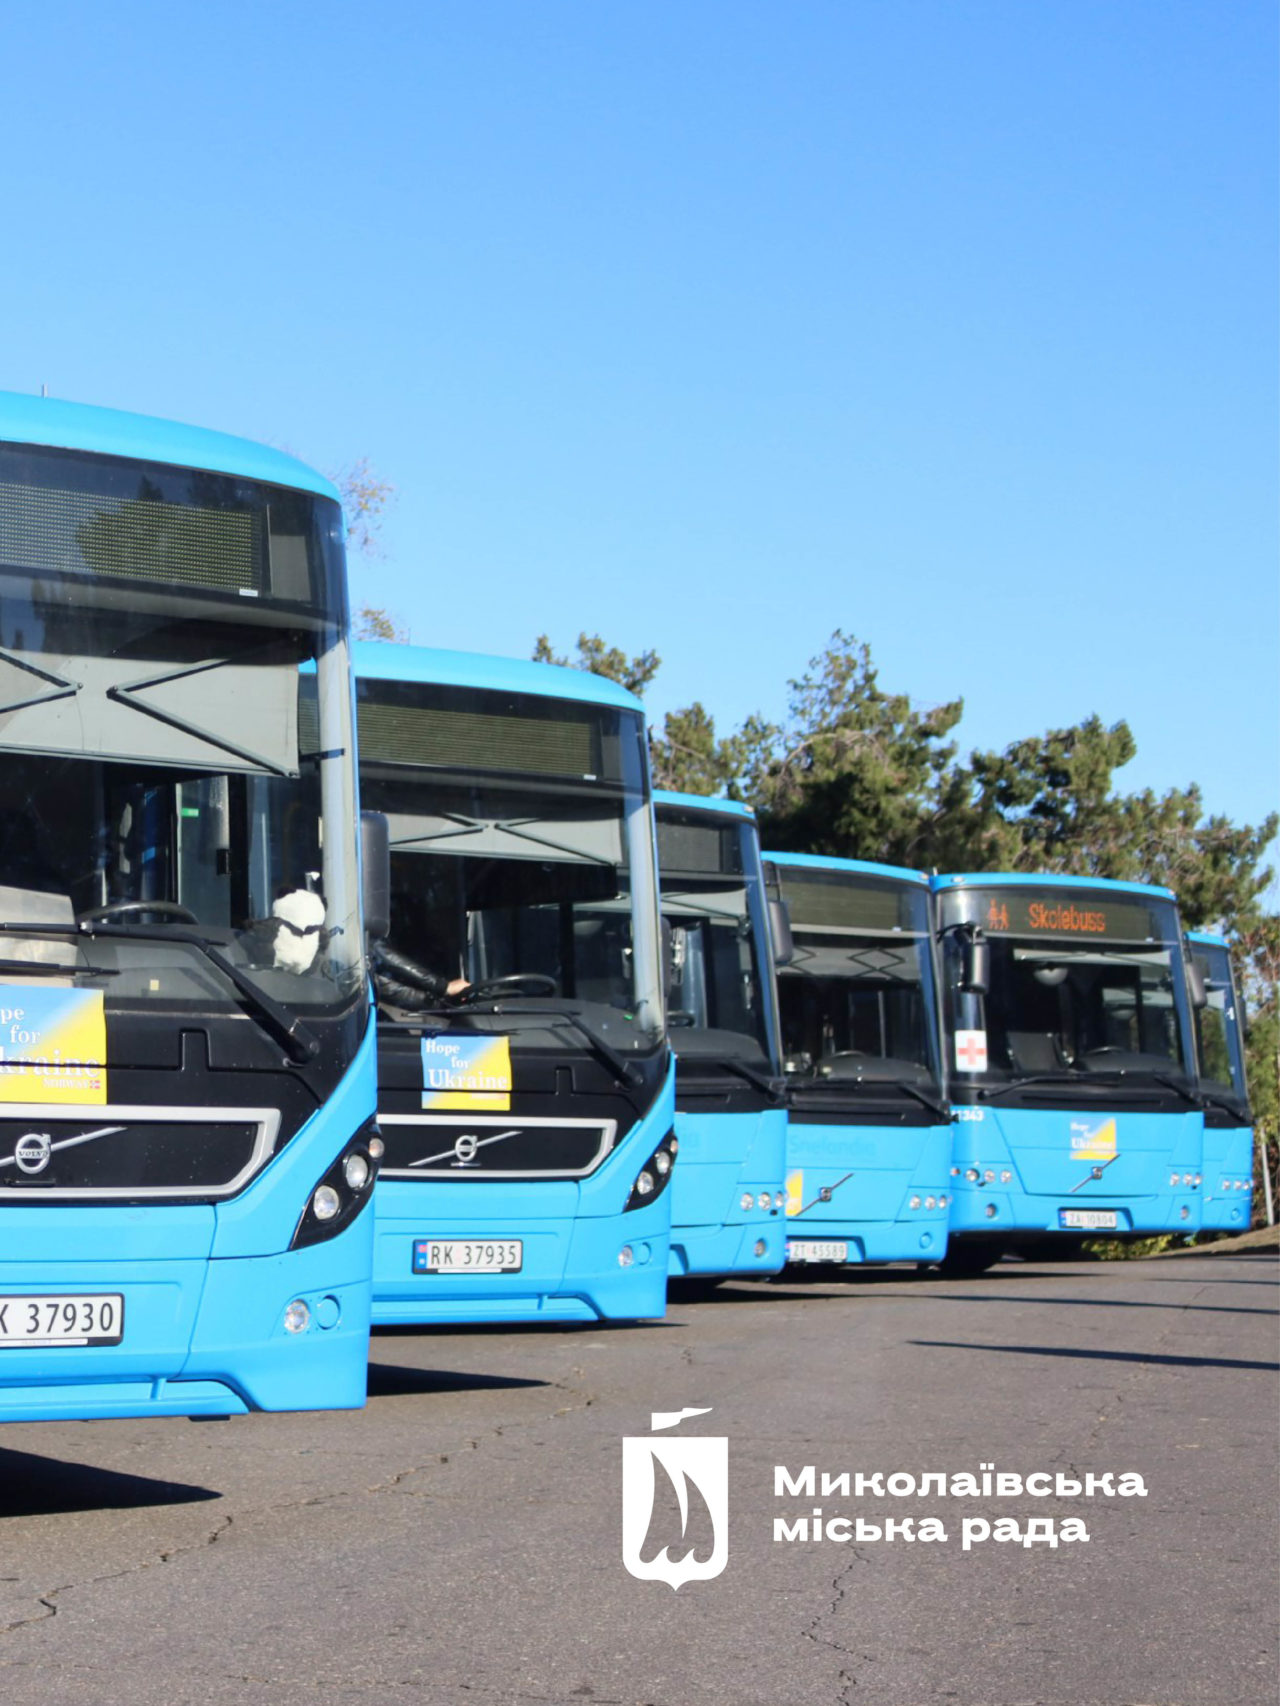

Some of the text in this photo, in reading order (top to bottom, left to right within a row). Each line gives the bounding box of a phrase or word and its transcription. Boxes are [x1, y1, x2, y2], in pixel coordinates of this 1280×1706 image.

[1028, 903, 1106, 932] Skolebuss
[10, 1024, 41, 1044] for
[425, 1039, 460, 1057] Hope
[451, 1056, 469, 1069] for
[428, 1068, 508, 1090] Ukraine
[431, 1245, 516, 1265] RK 37935
[26, 1302, 114, 1334] 37930
